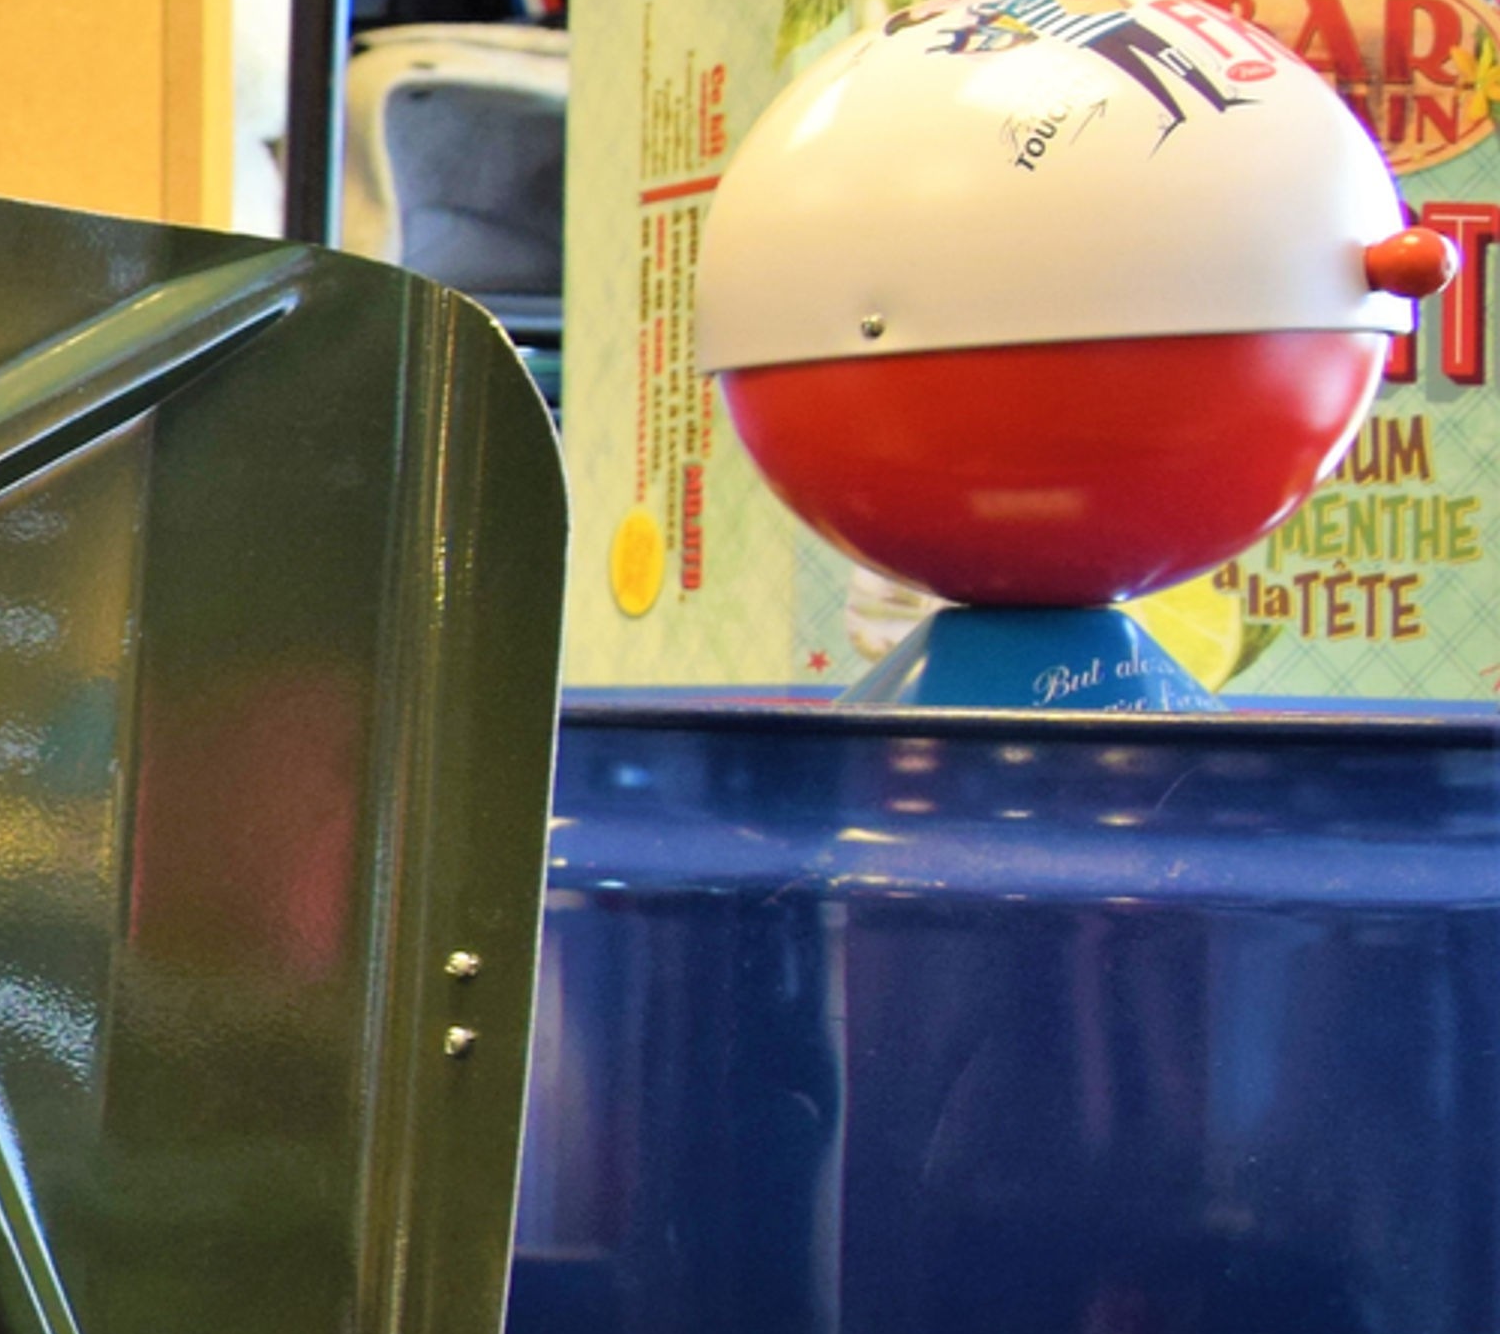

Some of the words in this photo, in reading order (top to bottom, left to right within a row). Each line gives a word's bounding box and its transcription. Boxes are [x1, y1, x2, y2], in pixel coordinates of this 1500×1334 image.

[1248, 573, 1291, 618] la
[1293, 558, 1423, 640] TÊTE
[1033, 658, 1101, 707] But
